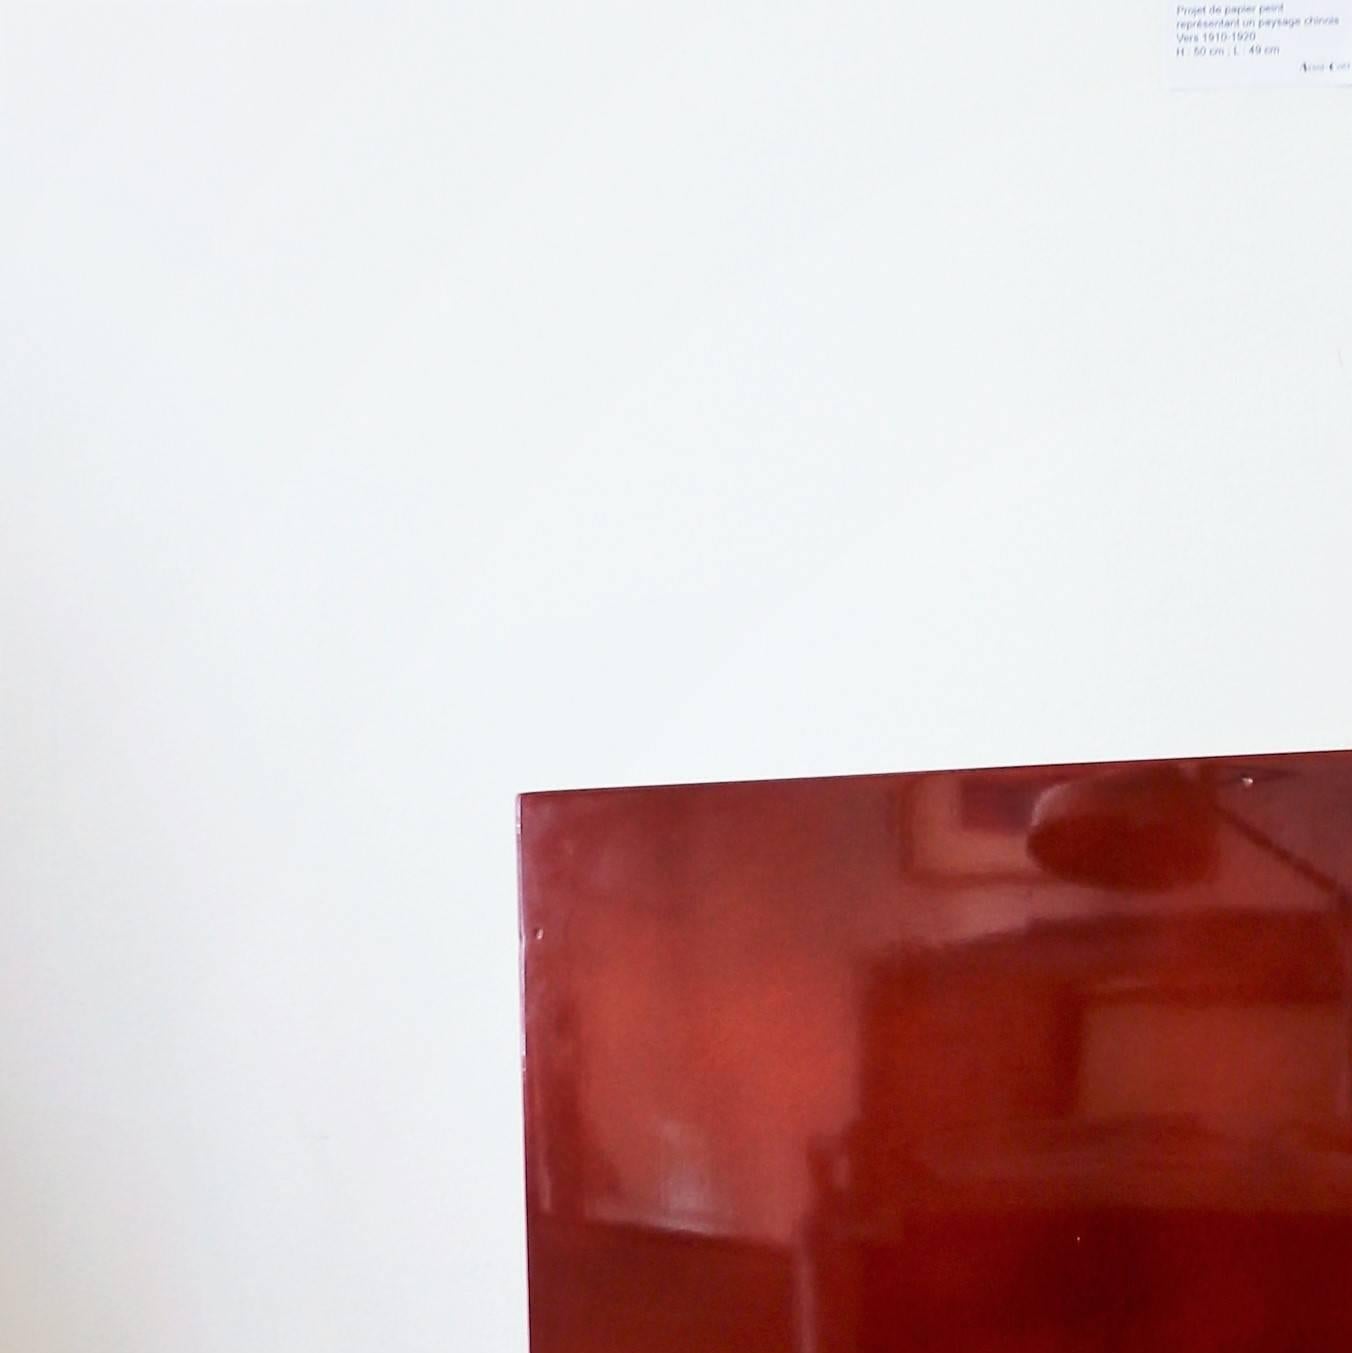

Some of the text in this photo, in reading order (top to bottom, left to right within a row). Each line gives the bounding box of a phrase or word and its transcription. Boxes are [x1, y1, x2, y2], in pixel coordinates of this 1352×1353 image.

[1177, 3, 1284, 17] Projet de papier peint
[1177, 15, 1339, 30] représentant un paysage chinois
[1176, 33, 1199, 43] Vers
[1177, 47, 1185, 57] H
[1193, 46, 1207, 56] 50
[1209, 47, 1225, 56] cm
[1233, 45, 1240, 56] L
[1248, 44, 1261, 55] 49
[1264, 46, 1280, 55] cm
